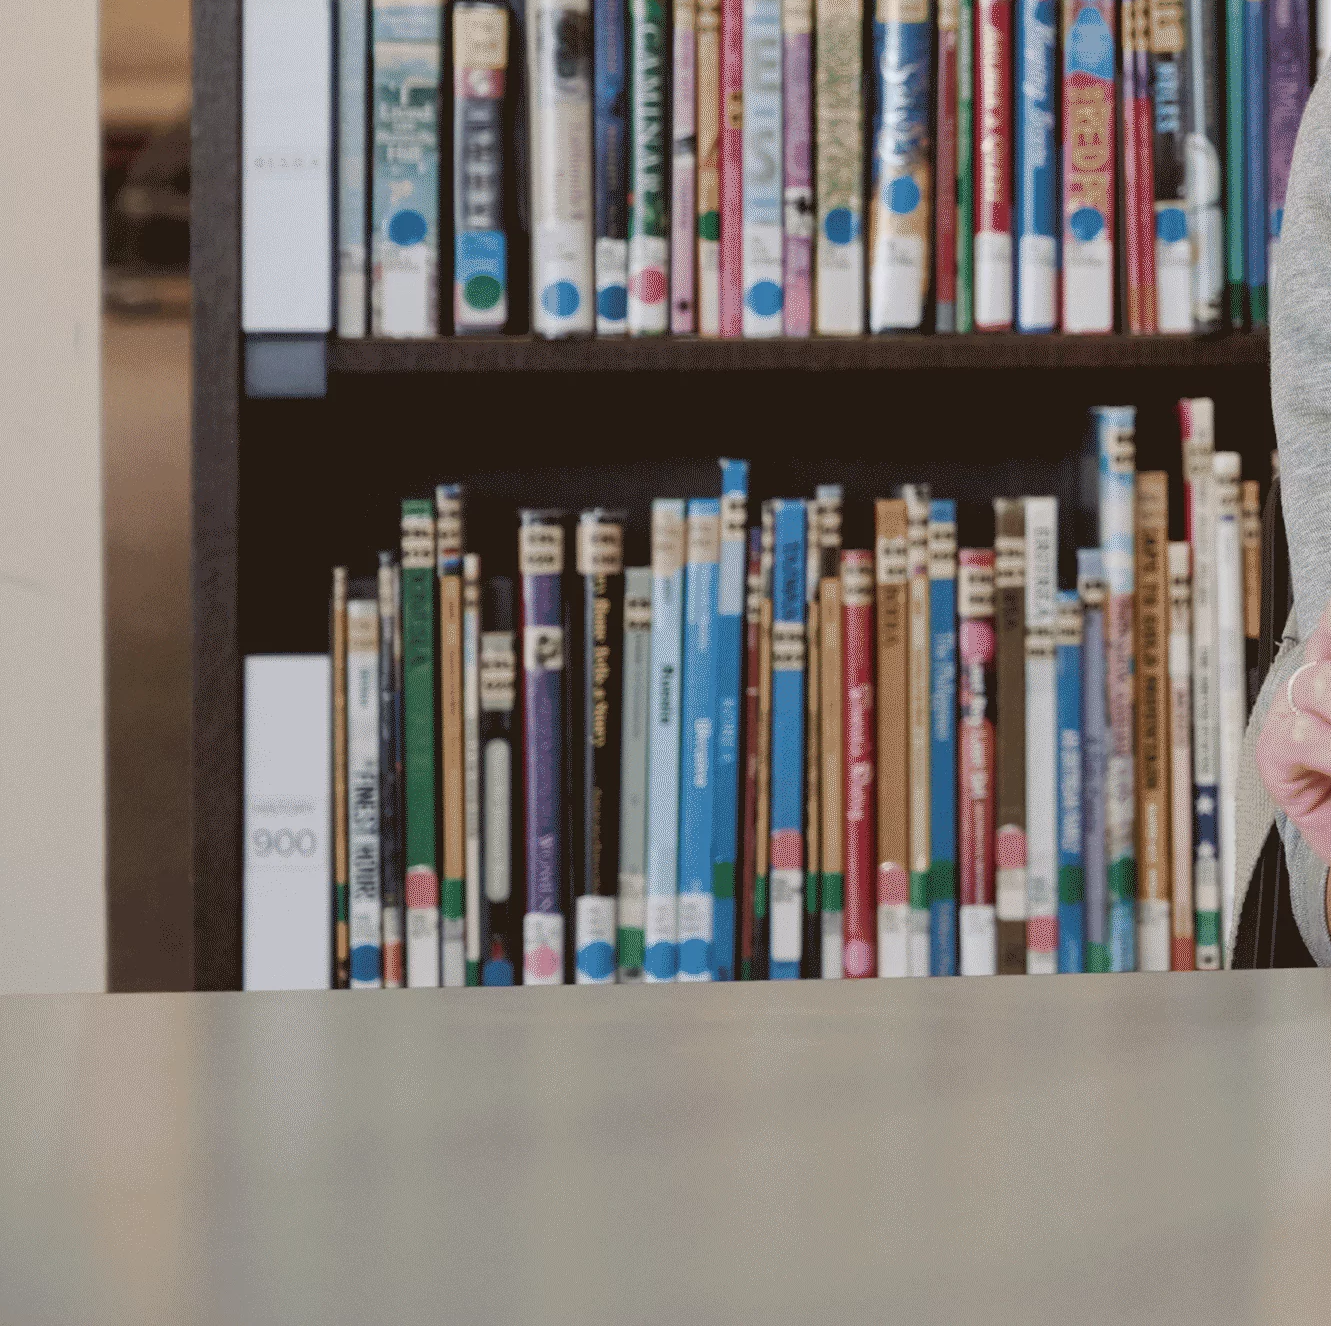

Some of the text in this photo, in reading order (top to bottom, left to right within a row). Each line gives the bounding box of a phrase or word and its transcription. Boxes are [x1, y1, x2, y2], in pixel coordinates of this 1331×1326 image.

[636, 22, 664, 194] CAMINAR
[1033, 526, 1050, 621] ERITREA
[658, 664, 681, 727] Russia
[252, 827, 316, 858] 900
